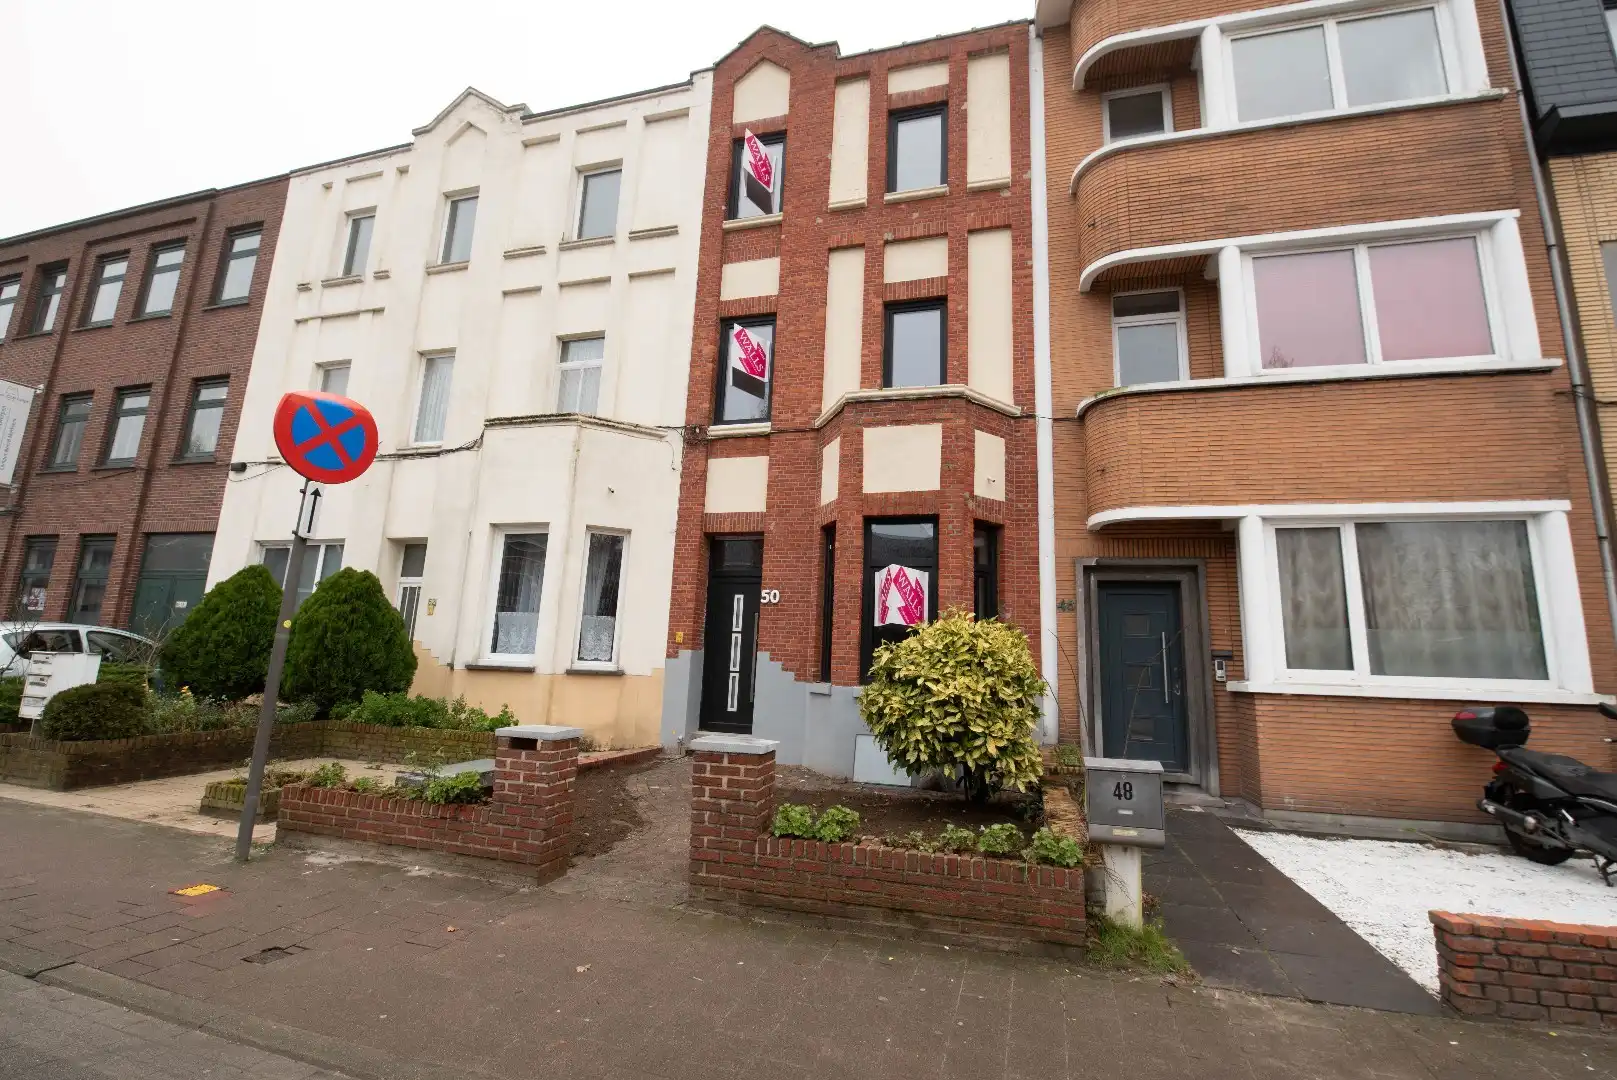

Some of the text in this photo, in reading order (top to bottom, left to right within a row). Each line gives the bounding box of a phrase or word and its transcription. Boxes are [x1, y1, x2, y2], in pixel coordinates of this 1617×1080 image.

[750, 138, 770, 181] WALLS
[740, 331, 764, 372] WALLS
[760, 589, 780, 604] 50
[898, 571, 921, 617] WALLS
[1113, 781, 1133, 801] 48
